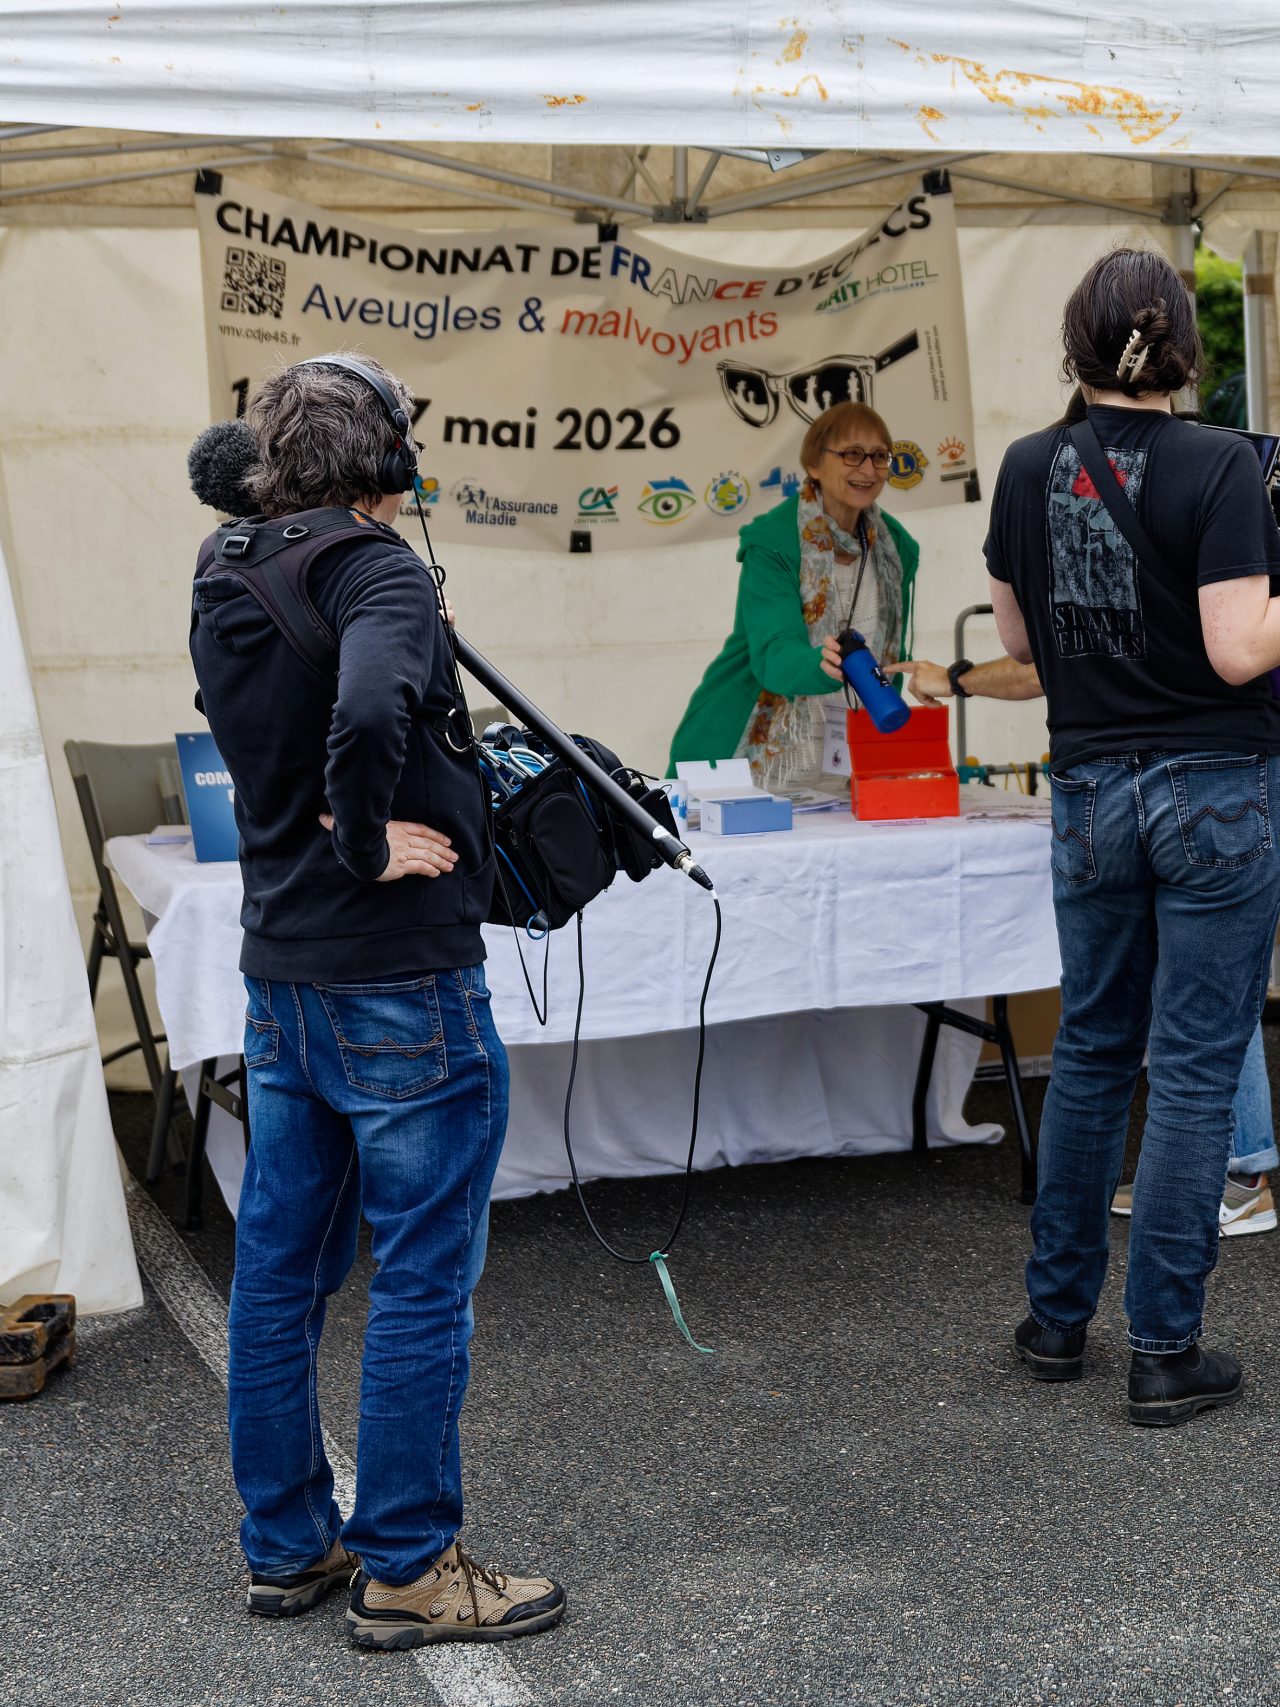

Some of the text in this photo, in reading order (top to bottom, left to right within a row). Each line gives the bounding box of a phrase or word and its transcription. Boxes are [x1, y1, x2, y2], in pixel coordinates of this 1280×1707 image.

[216, 201, 539, 275] CHAMPIONNAT
[550, 246, 600, 279] DE
[610, 245, 767, 304] FRANCE
[866, 259, 939, 292] HOTEL
[302, 283, 779, 365] Aveugles & malvoyants
[443, 406, 538, 450] mai
[553, 408, 681, 450] 2026
[465, 509, 517, 527] Maladie
[485, 496, 558, 515] l'Assurance
[194, 771, 234, 786] COM
